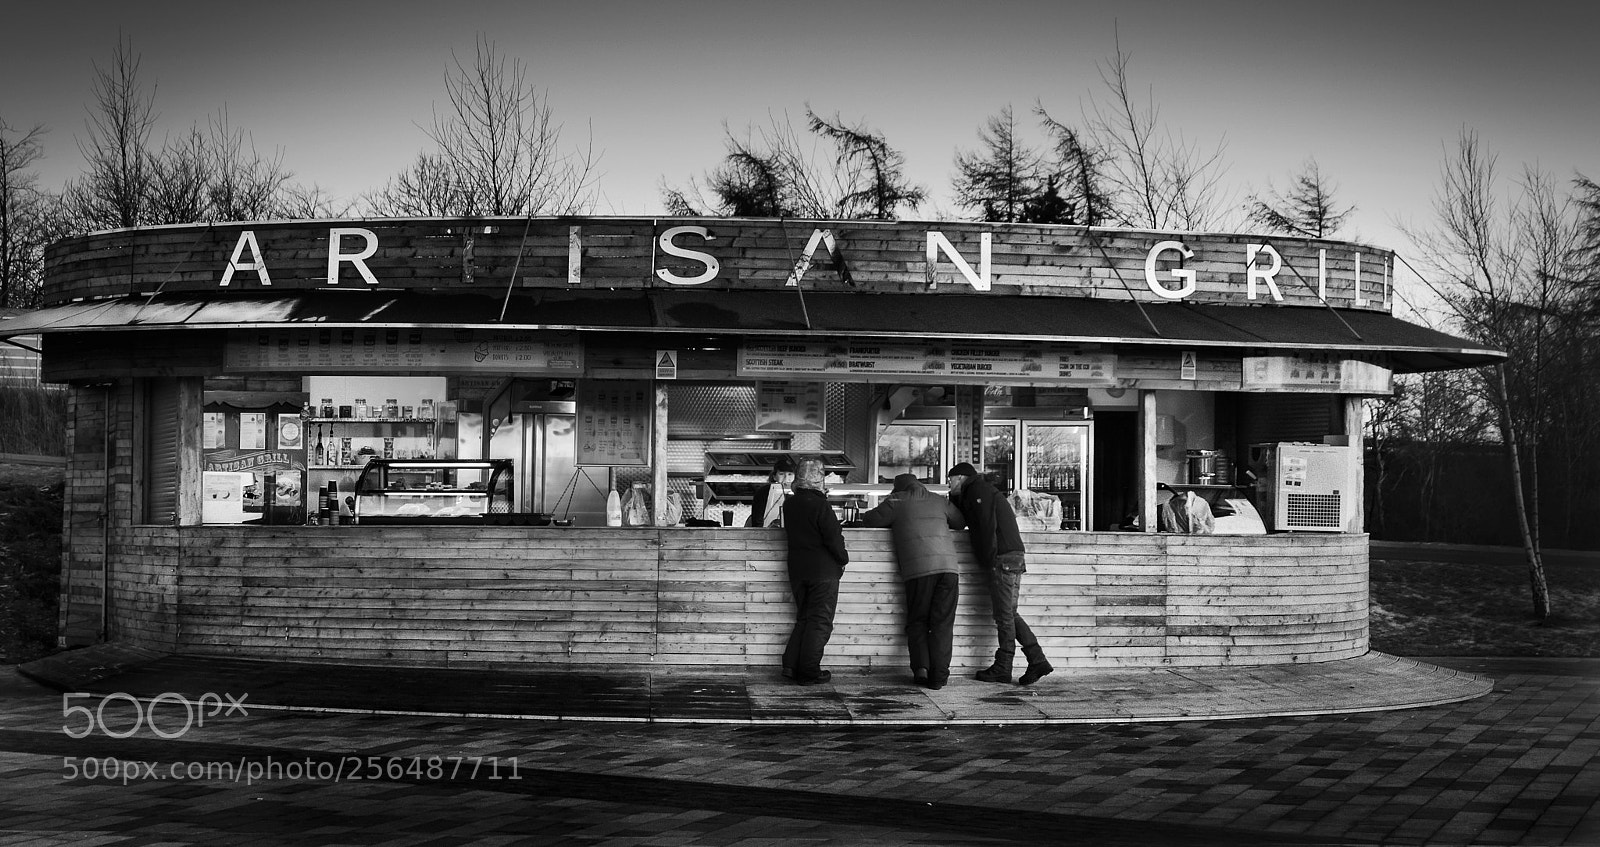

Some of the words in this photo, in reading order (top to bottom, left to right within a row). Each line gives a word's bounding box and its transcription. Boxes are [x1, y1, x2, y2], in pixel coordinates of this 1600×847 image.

[219, 225, 993, 291] ARTISAN
[1145, 240, 1391, 309] GRILL
[206, 457, 254, 472] ARTISAN
[257, 453, 289, 464] GRILL
